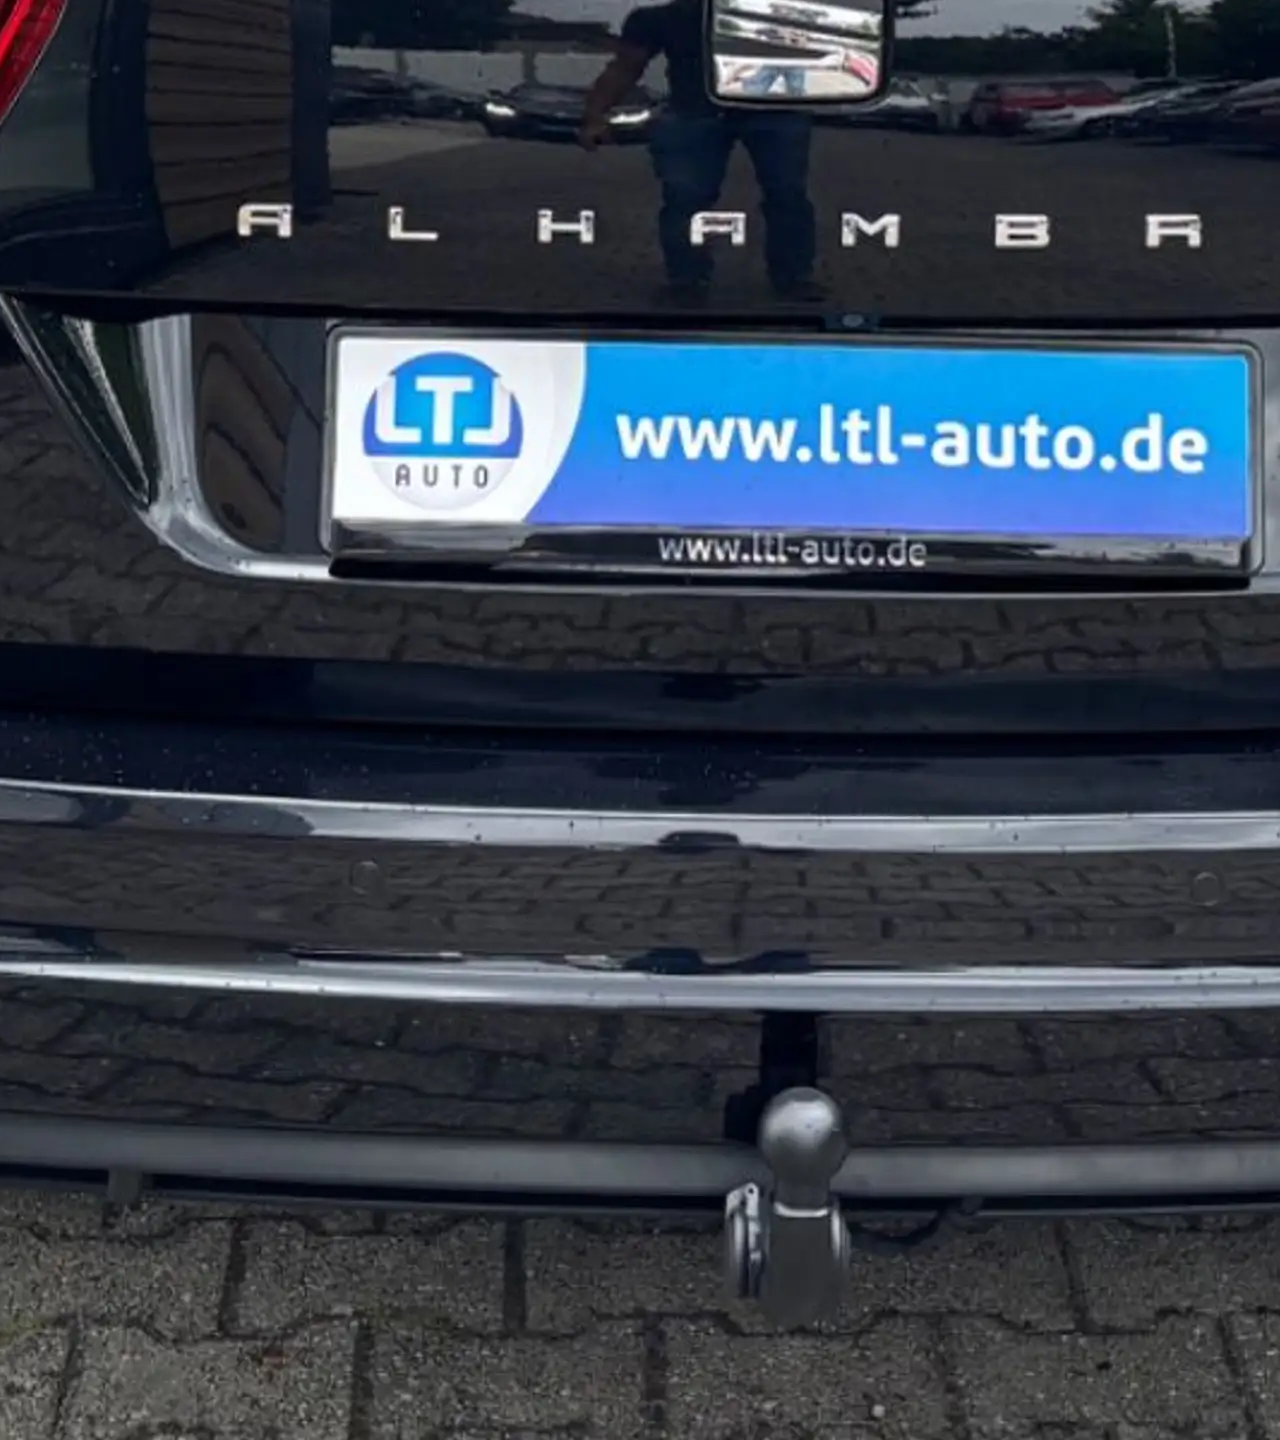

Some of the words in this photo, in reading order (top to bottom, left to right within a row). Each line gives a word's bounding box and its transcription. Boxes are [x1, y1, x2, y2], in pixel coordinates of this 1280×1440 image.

[615, 403, 1209, 474] www.ltl-auto.de
[394, 463, 489, 488] AUTO
[658, 533, 928, 568] www.ltl-auto.de
